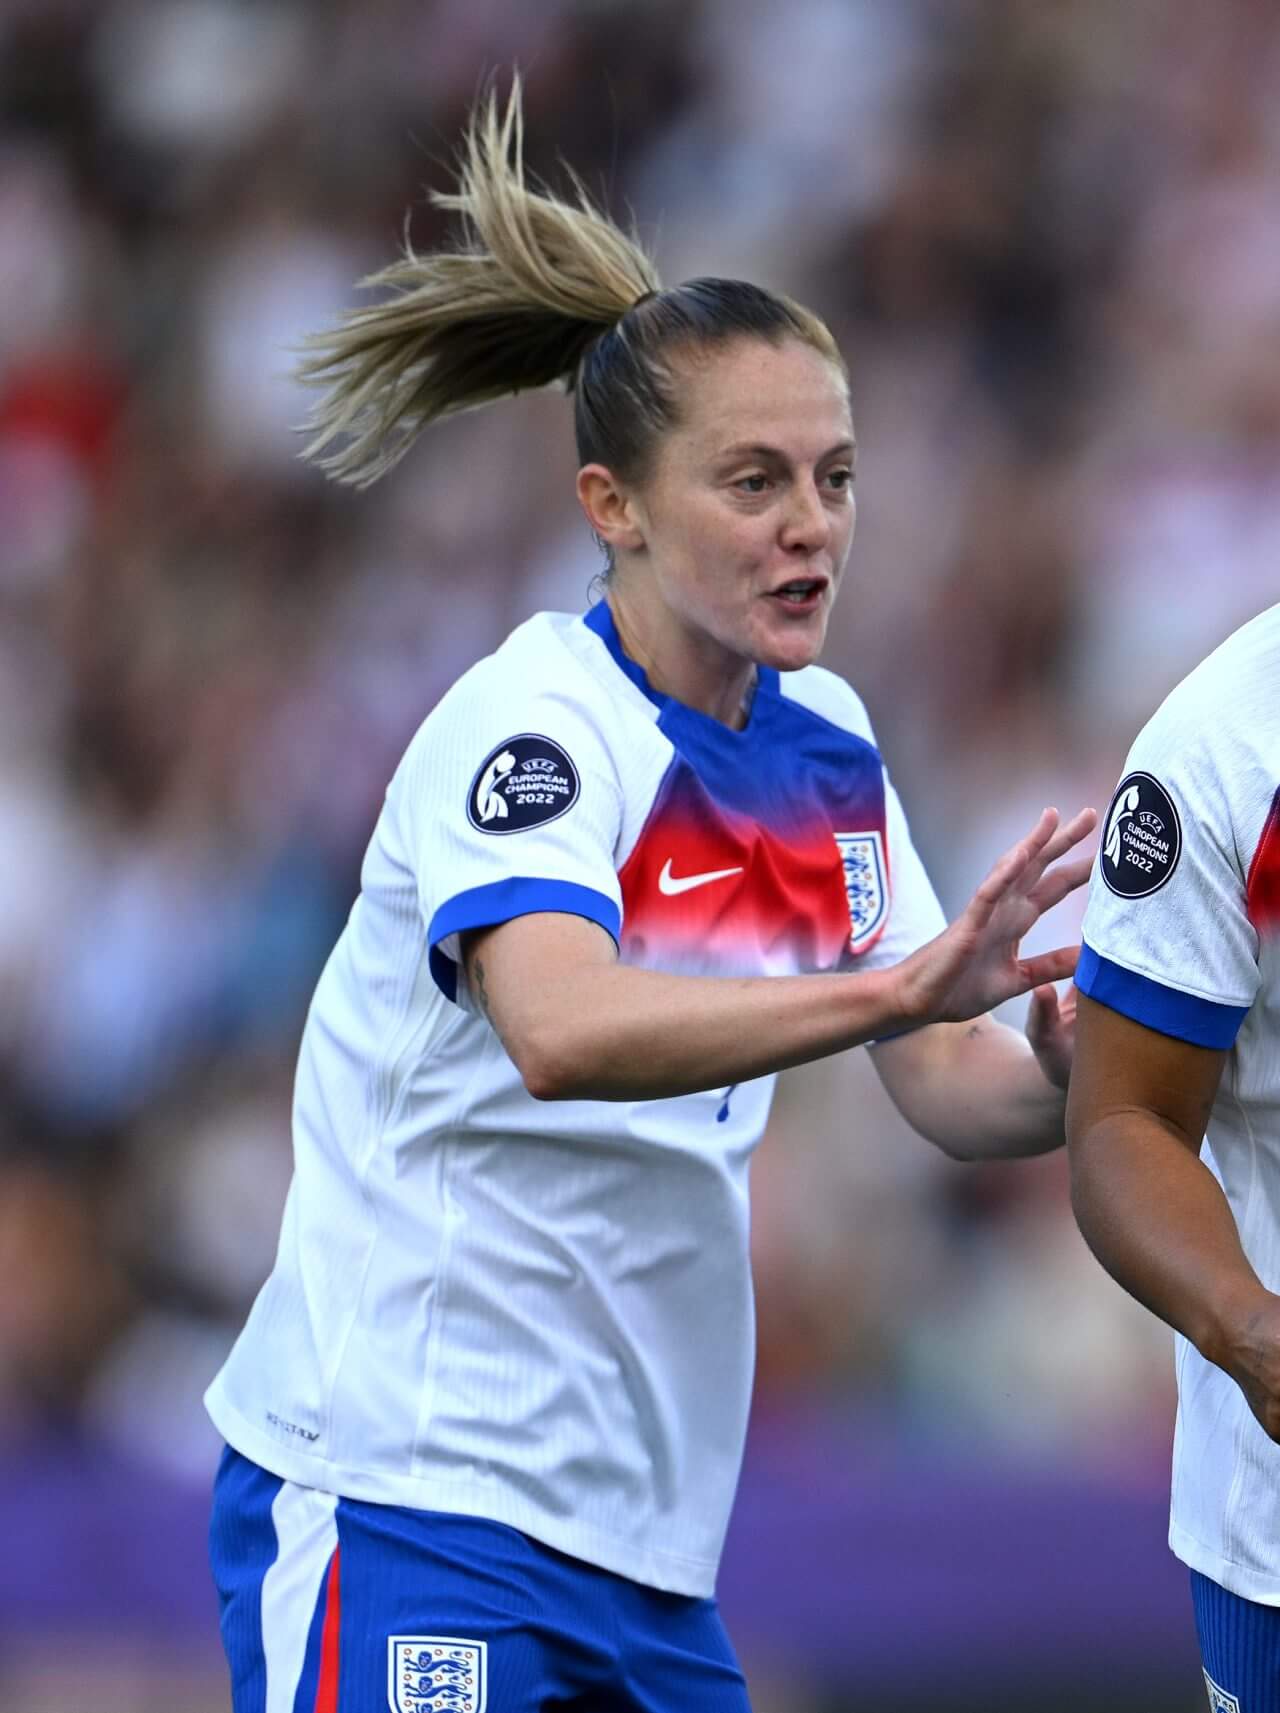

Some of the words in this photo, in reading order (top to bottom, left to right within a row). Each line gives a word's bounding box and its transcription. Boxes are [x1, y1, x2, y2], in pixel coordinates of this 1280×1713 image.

[505, 783, 570, 795] CHAMPIONS
[508, 774, 569, 786] EUROPEAN
[516, 794, 555, 804] 2022
[1139, 813, 1162, 833] UEFA
[1122, 831, 1169, 864] CHAMPIONS
[1127, 822, 1169, 853] EUROPEAN
[1125, 850, 1154, 873] 2022
